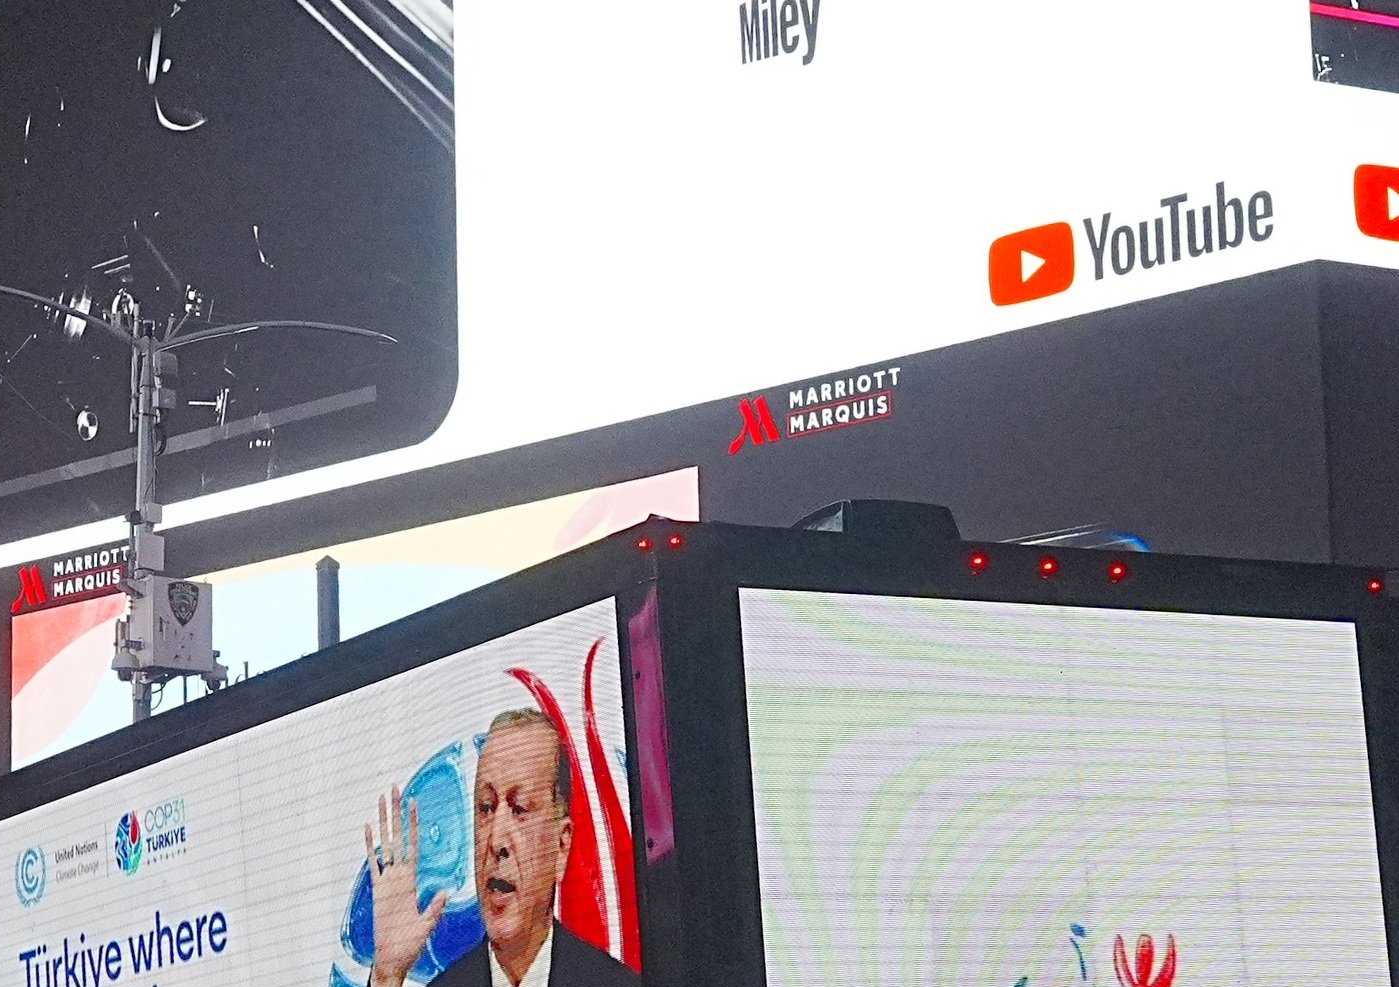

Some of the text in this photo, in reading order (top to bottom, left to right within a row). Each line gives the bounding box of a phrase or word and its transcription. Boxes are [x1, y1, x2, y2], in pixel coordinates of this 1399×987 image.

[739, 0, 821, 66] Miley
[1083, 181, 1274, 280] YouTube
[789, 367, 901, 409] MARRIOTT
[790, 395, 888, 433] MARQUIS
[53, 545, 130, 577] MARRIOTT
[53, 569, 120, 598] MARQUIS
[144, 799, 187, 833] COP31
[54, 839, 99, 864] United Nations
[128, 910, 228, 973] where
